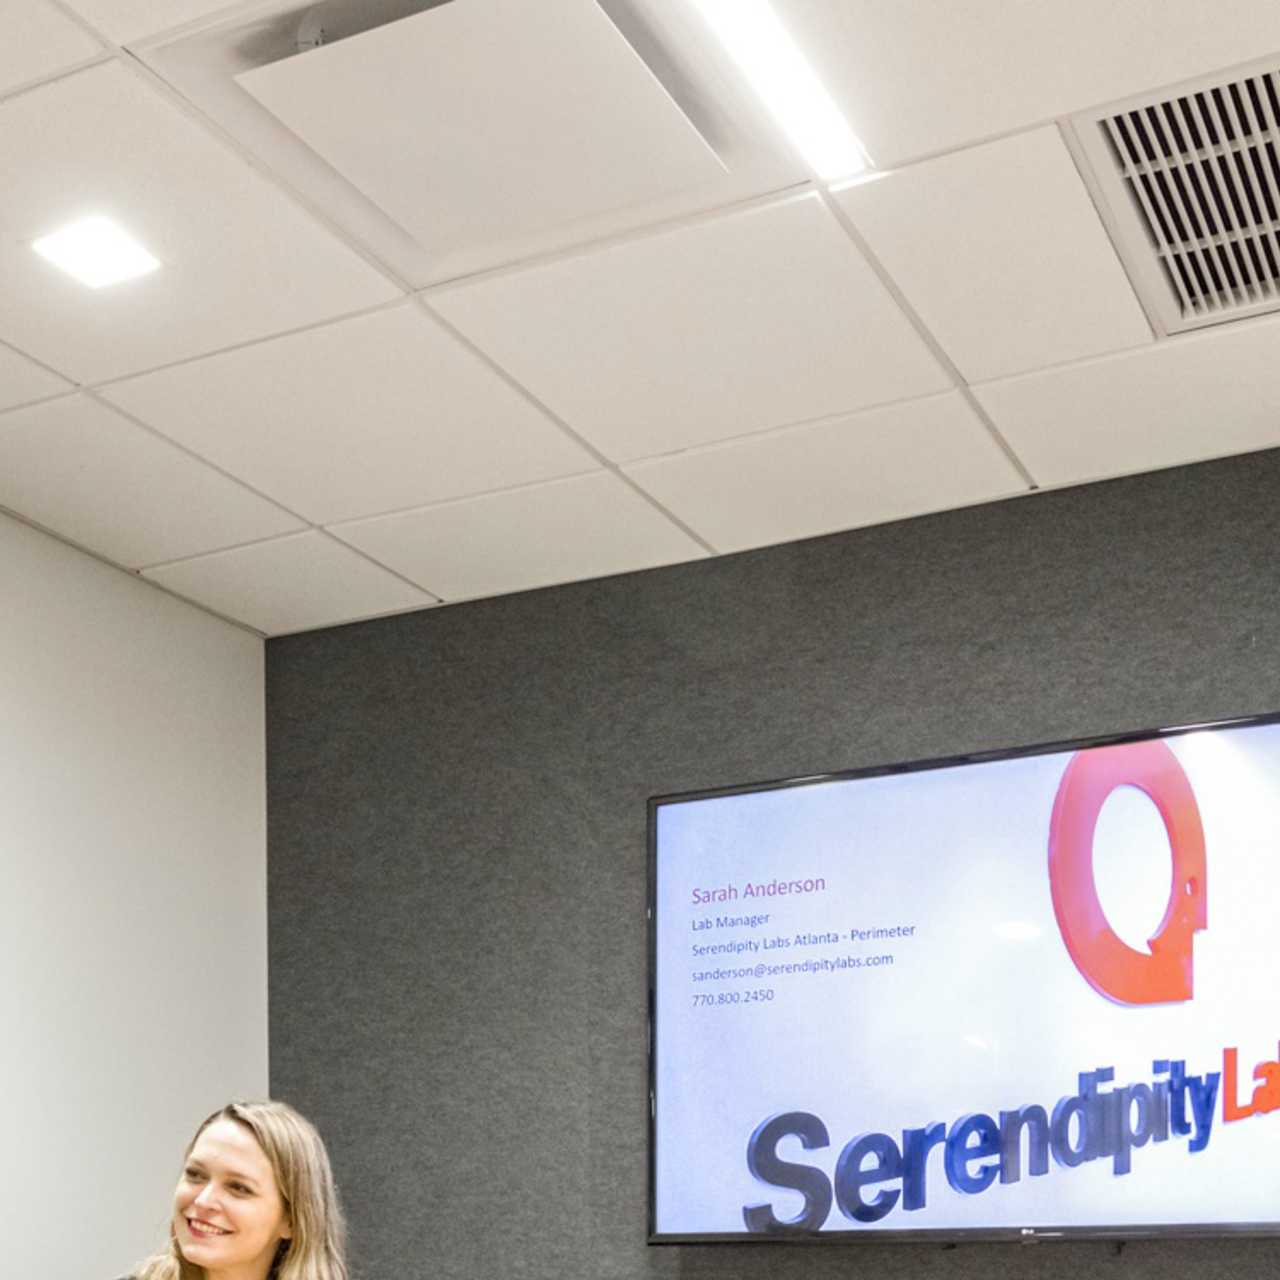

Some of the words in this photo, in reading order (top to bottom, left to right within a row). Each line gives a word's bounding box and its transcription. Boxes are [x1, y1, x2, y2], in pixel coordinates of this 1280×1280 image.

[691, 884, 738, 905] Sarah
[743, 877, 826, 899] Anderson
[691, 917, 712, 931] Lab
[716, 913, 770, 929] Manager
[691, 938, 760, 957] Serendipity
[763, 934, 791, 950] Labs
[793, 930, 839, 946] Atlanta
[851, 924, 916, 942] Perimeter
[691, 953, 894, 982] sanderson@serendipitylabs.com
[691, 988, 775, 1007] 770.800.2450
